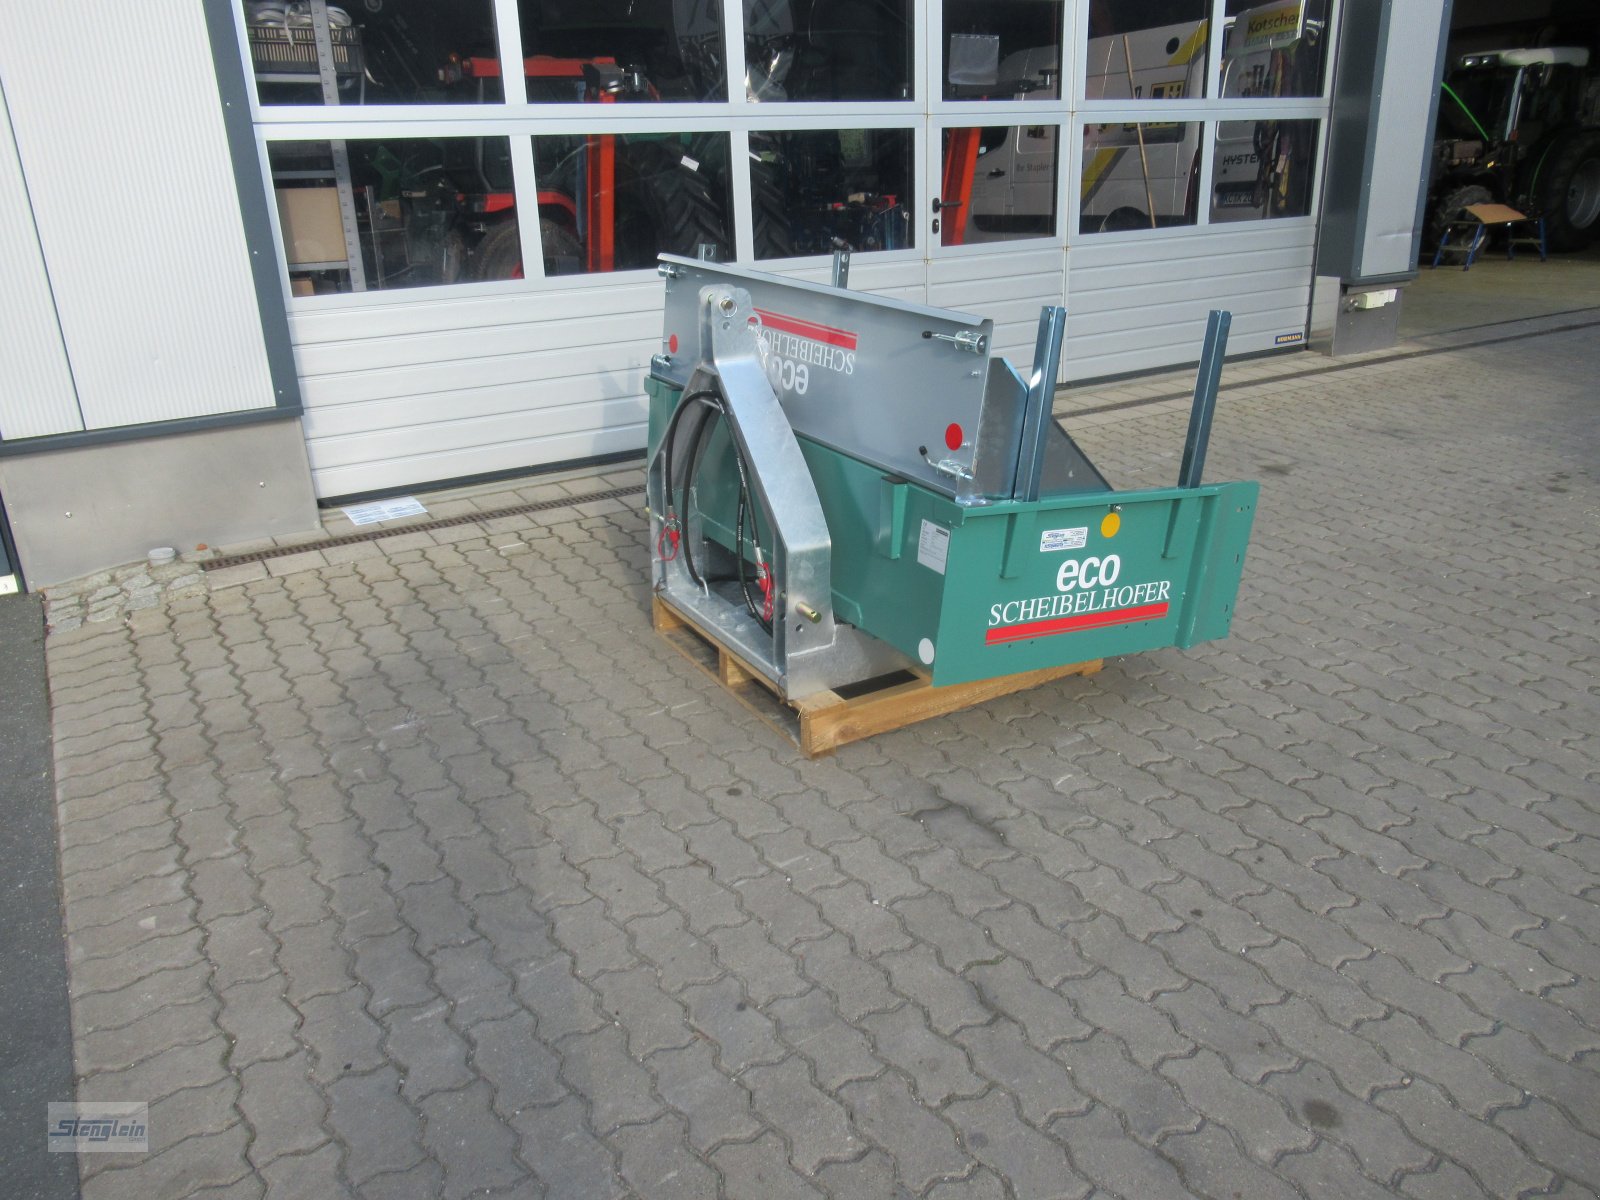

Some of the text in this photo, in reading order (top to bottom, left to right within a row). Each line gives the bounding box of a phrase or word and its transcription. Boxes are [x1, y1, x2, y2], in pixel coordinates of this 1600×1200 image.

[761, 329, 856, 375] SCHEIBELHO
[1056, 554, 1121, 592] eco
[988, 580, 1171, 626] SCHEIBELHOFER
